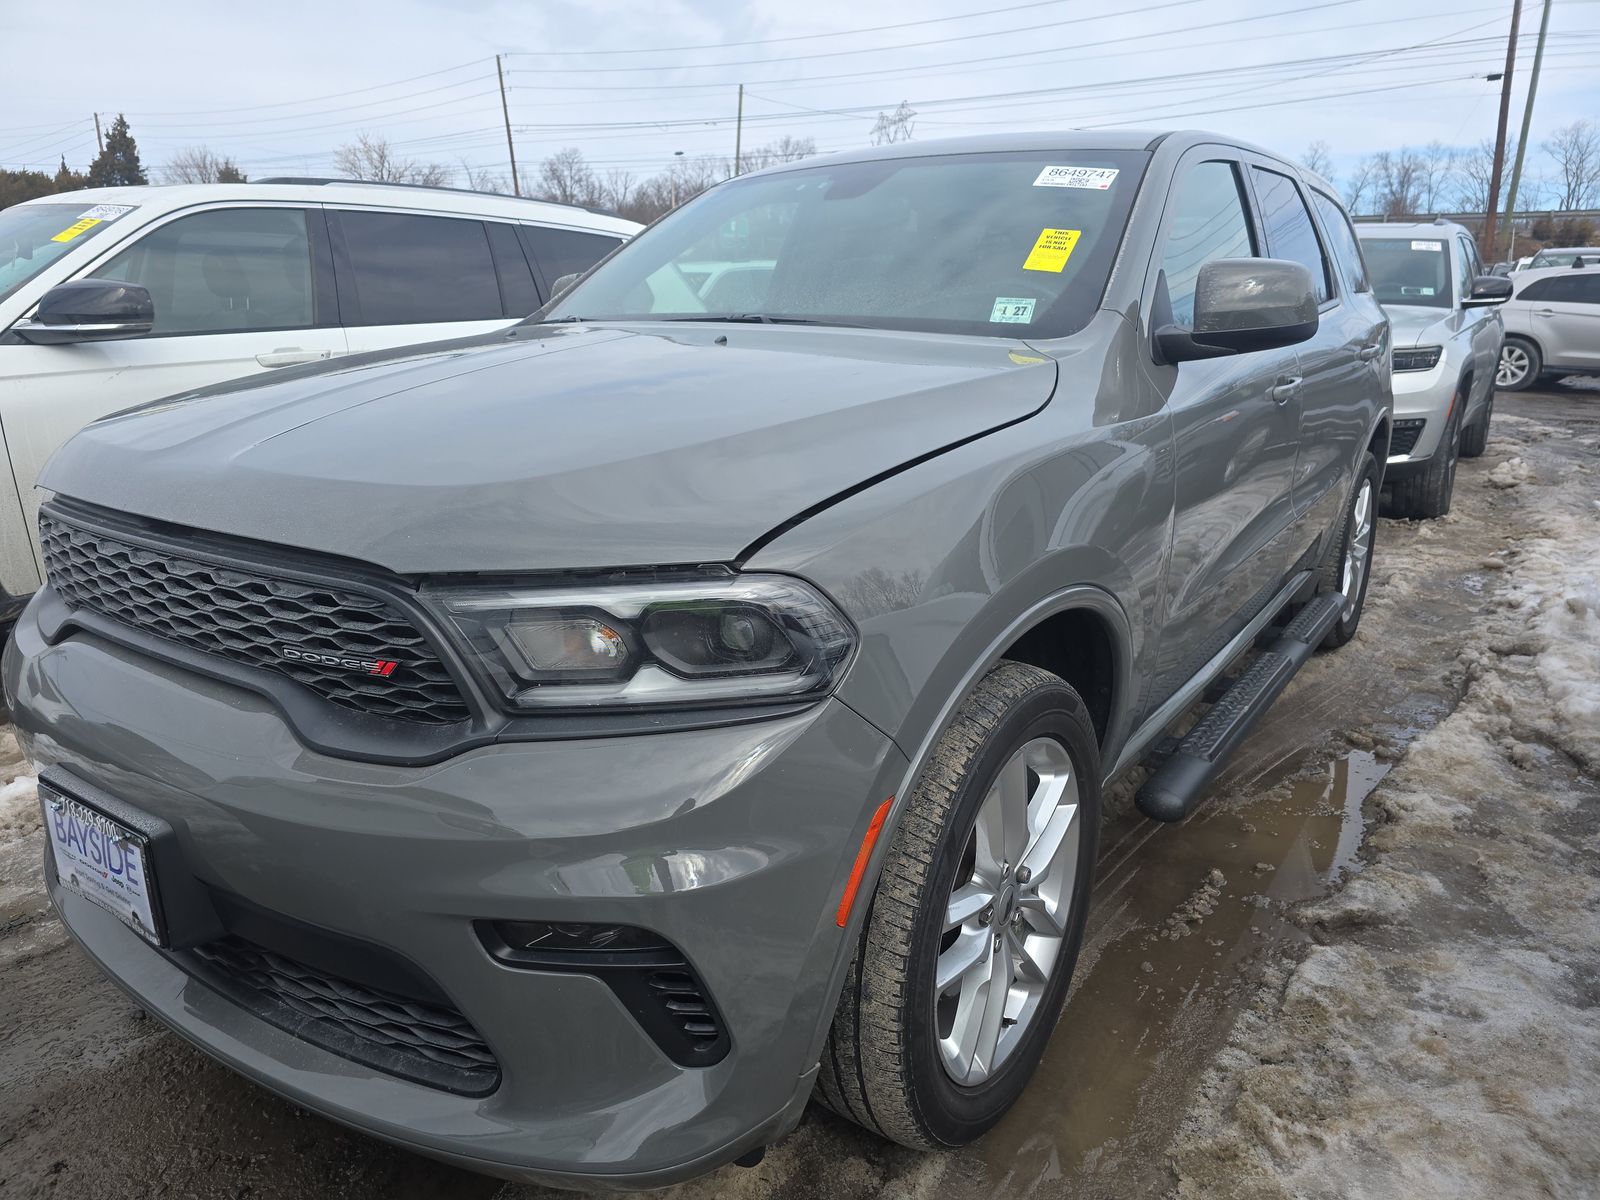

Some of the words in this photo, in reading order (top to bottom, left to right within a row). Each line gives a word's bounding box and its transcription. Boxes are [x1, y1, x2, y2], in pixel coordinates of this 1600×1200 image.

[1048, 168, 1116, 179] 8649747
[1001, 306, 1008, 316] 1
[1013, 306, 1027, 316] 27
[283, 648, 381, 672] DODGE
[53, 811, 138, 886] BAYSIDE
